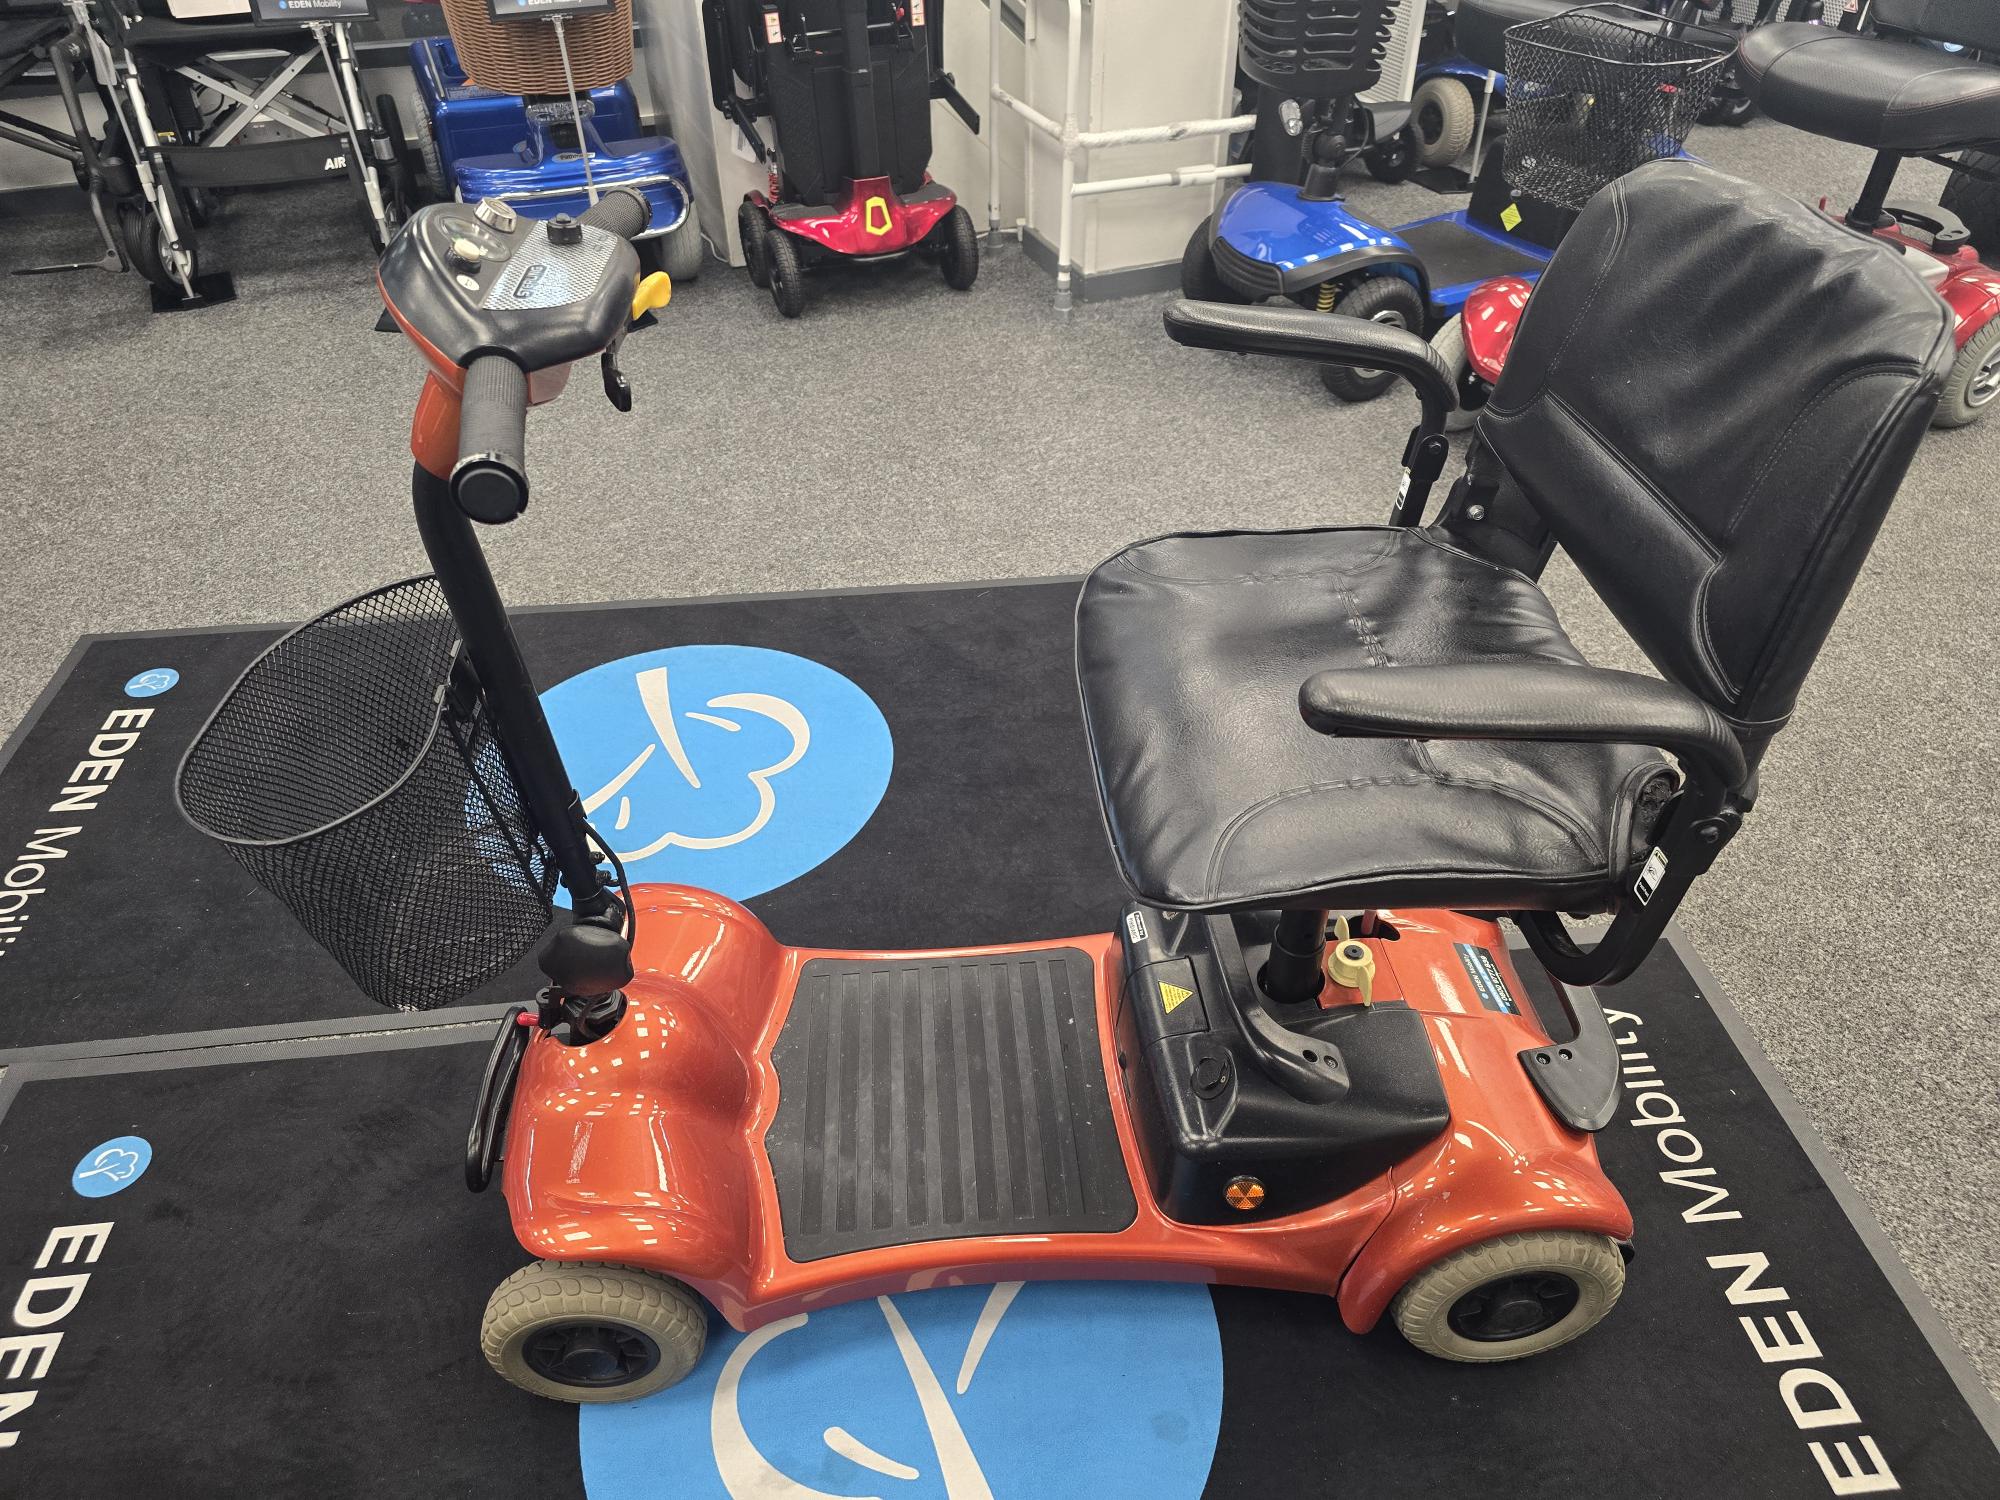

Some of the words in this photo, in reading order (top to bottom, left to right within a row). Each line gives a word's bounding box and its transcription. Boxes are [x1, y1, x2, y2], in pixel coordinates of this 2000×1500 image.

[288, 1, 313, 9] EDEN
[313, 0, 342, 9] Mobility
[324, 156, 347, 170] AIR
[48, 708, 155, 813] EDEN
[1602, 1007, 1743, 1224] Mobility
[1706, 1251, 1901, 1496] EDEN
